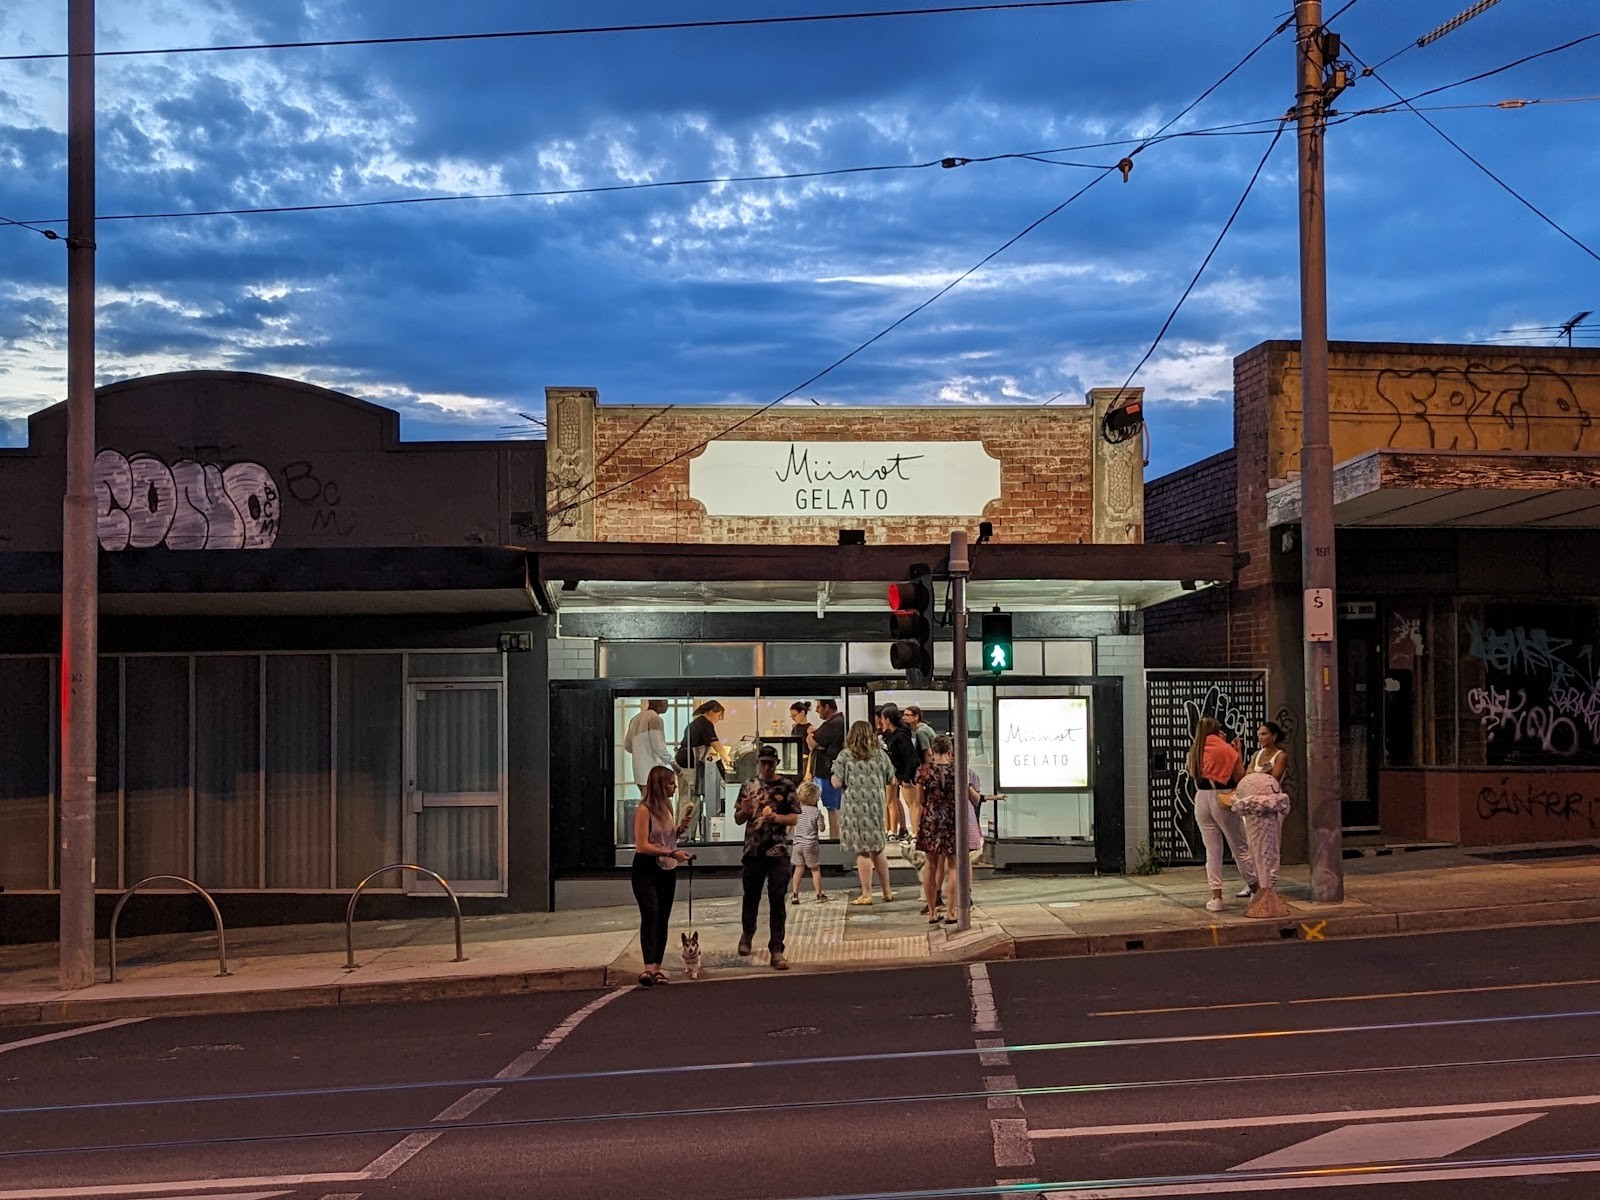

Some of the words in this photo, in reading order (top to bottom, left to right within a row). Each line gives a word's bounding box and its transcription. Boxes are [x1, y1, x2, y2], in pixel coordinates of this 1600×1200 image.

[796, 489, 888, 509] GELATO
[1314, 546, 1330, 557] 191
[1314, 596, 1324, 608] S
[1014, 754, 1068, 766] GELATO
